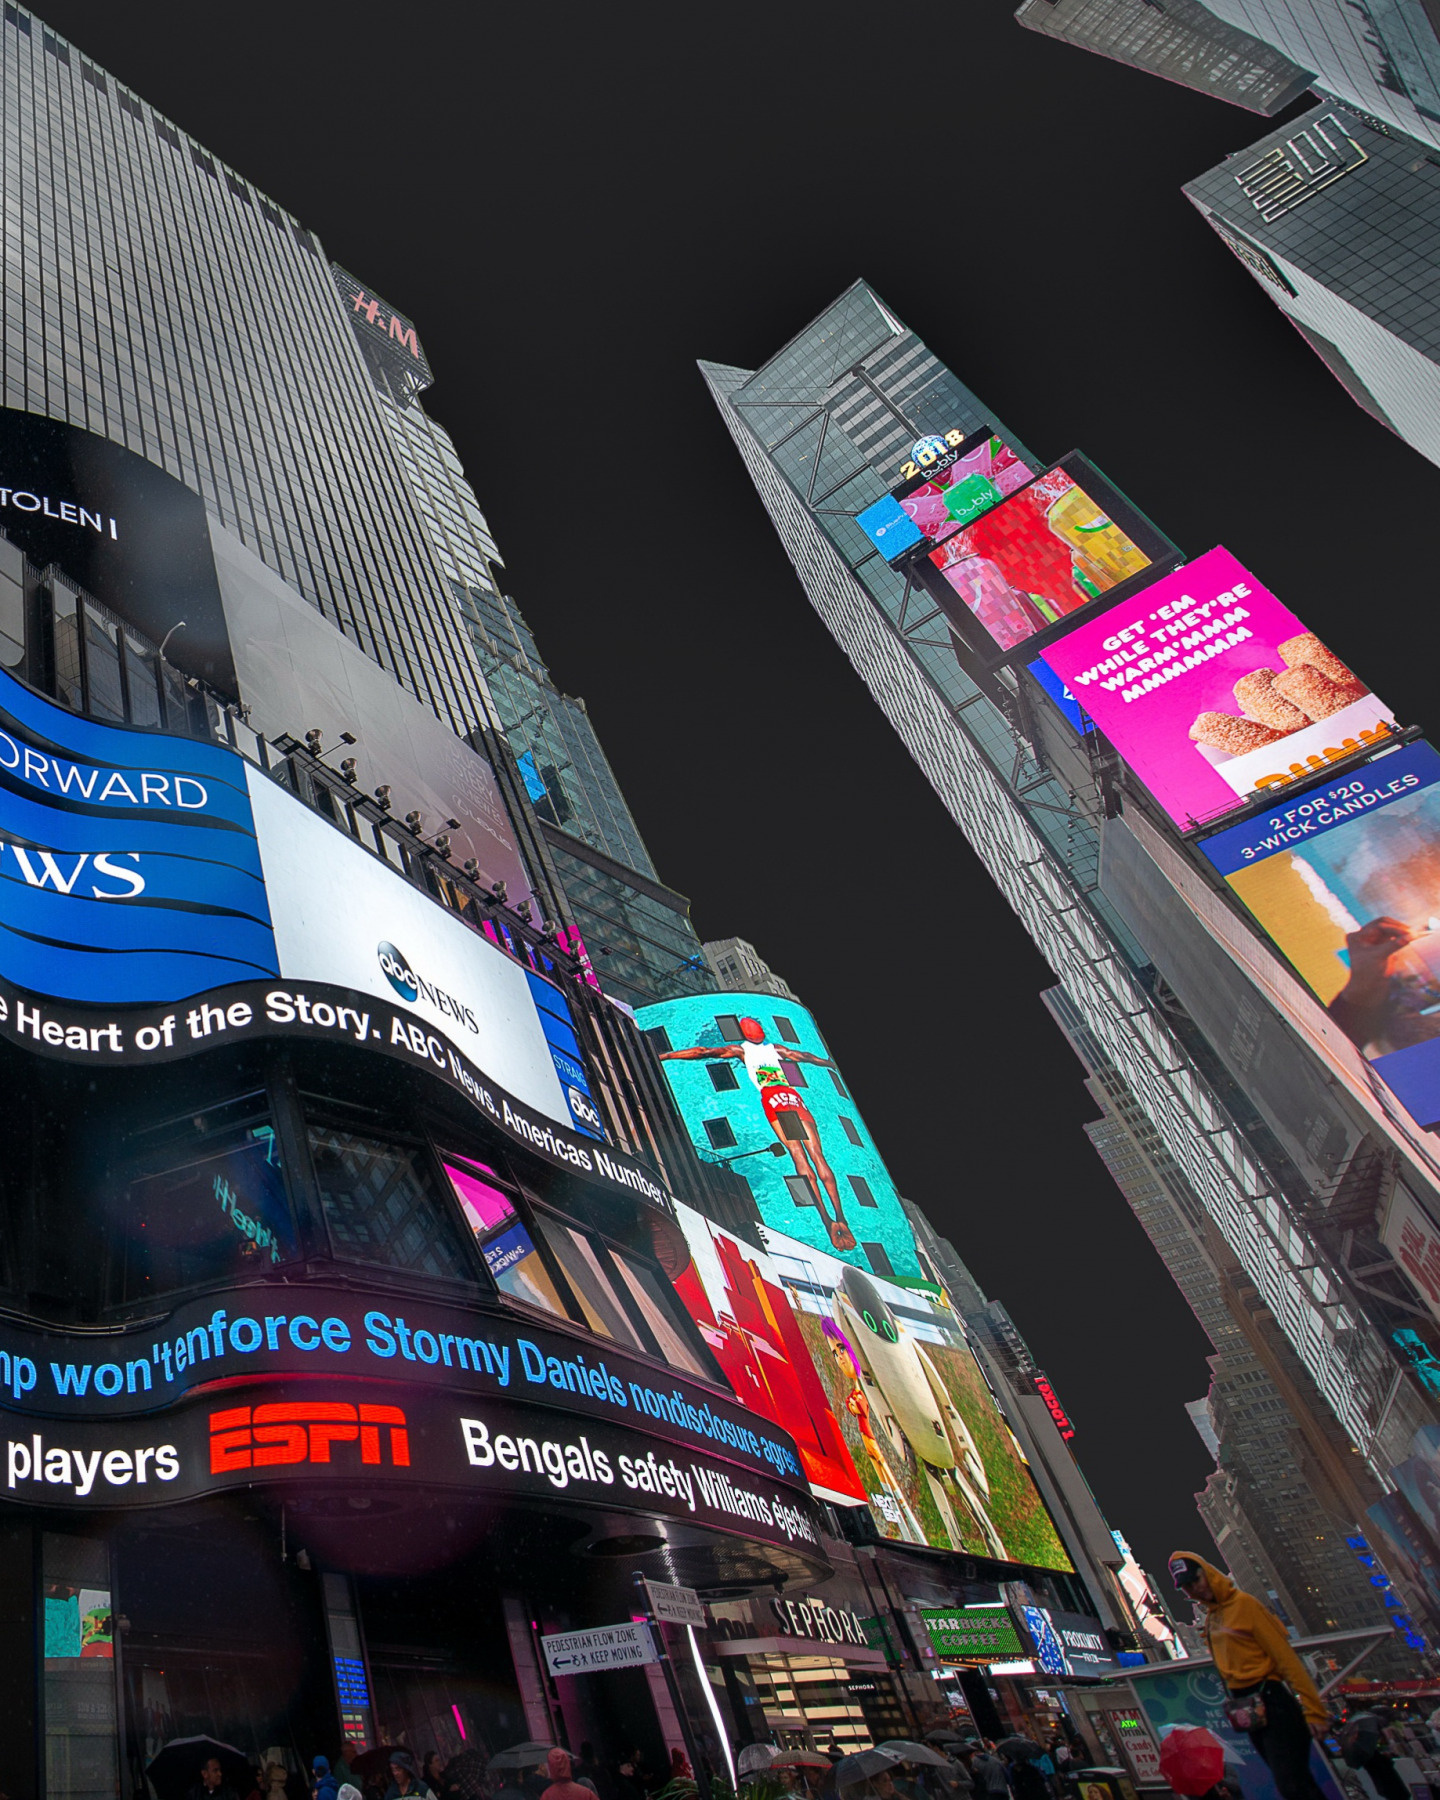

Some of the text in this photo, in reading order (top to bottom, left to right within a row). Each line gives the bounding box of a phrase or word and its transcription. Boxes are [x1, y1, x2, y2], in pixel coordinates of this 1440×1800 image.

[349, 291, 419, 359] H&M
[900, 429, 964, 480] 2018
[955, 489, 994, 516] bubly
[1074, 582, 1252, 686] WHILE THEY'RE
[1102, 594, 1197, 651] GET 'EM
[1099, 606, 1251, 692] WARM'MMM
[1122, 626, 1253, 703] MMMMMM
[1240, 819, 1318, 860] 3-WICK
[1316, 774, 1421, 826] CANDLES
[1268, 817, 1285, 831] 2
[1284, 798, 1329, 824] FOR
[1328, 781, 1366, 800] $20
[379, 950, 417, 991] abc
[415, 981, 480, 1036] NEWS
[16, 1001, 123, 1053] Heart
[136, 1015, 175, 1051] of
[186, 995, 253, 1039] the
[266, 989, 382, 1041] Story.
[389, 1016, 446, 1069] ABC
[449, 1049, 502, 1119] News.
[504, 1099, 593, 1171] Americas
[593, 1148, 665, 1206] Number
[570, 1096, 600, 1128] abc
[365, 1311, 510, 1387] Stormy
[516, 1338, 627, 1411] Daniels
[627, 1378, 762, 1458] nondisclosure
[7, 1433, 180, 1496] players
[209, 1402, 410, 1475] ESPN
[459, 1417, 613, 1488] Bengals
[620, 1451, 696, 1512] safety
[690, 1464, 774, 1526] Williams
[547, 1628, 637, 1654] PEDESTRIAN FLOW ZONE
[774, 1597, 869, 1646] SEPHORA
[924, 1616, 1011, 1632] STARBUCKS
[941, 1634, 1000, 1647] COFFEE
[589, 1645, 643, 1664] KEEP MOVING
[1112, 1710, 1140, 1721] ATM
[1119, 1726, 1147, 1737] Drink
[1120, 1719, 1138, 1728] ATM
[1125, 1740, 1153, 1752] Candy
[1135, 1754, 1158, 1763] ATM
